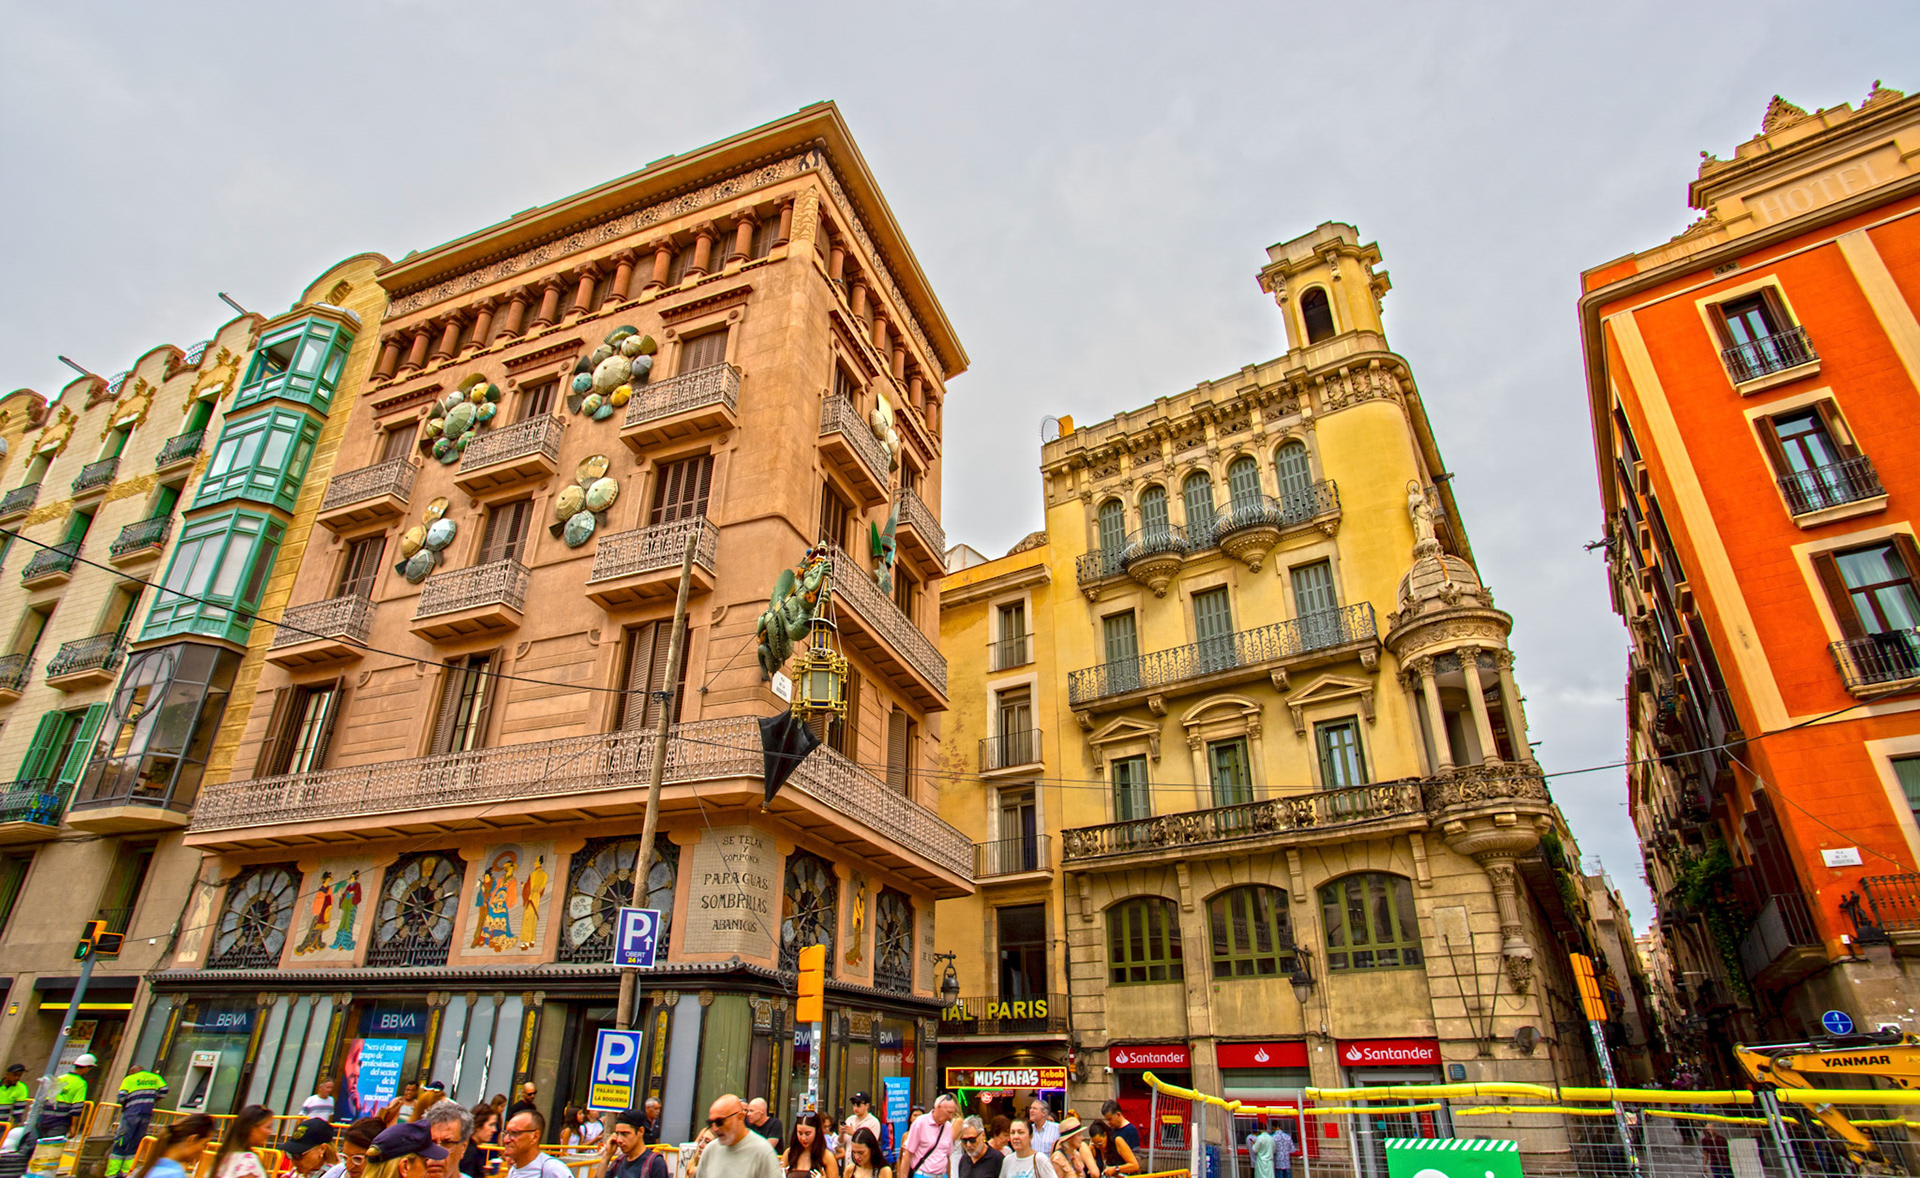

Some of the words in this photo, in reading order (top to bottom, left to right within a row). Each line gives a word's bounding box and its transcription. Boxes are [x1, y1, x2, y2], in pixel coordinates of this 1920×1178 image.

[1756, 160, 1894, 223] HOTEL
[722, 836, 735, 845] SE
[703, 872, 768, 890] PARAGUAS
[701, 894, 767, 913] SOMBRILLAS
[623, 912, 651, 950] P
[712, 919, 757, 933] ABANICOS
[987, 1000, 1047, 1020] PARIS
[216, 1013, 246, 1026] BBVA
[381, 1013, 415, 1028] BBVA
[794, 1031, 812, 1046] BVA
[880, 1032, 893, 1044] BVA
[597, 1034, 634, 1081] P
[1130, 1052, 1185, 1064] Santander
[1364, 1046, 1433, 1060] Santander
[1821, 1055, 1890, 1067] YANMAR
[974, 1069, 1039, 1086] MUSTAFA'S
[1040, 1070, 1064, 1078] Kebab
[1040, 1079, 1063, 1087] House
